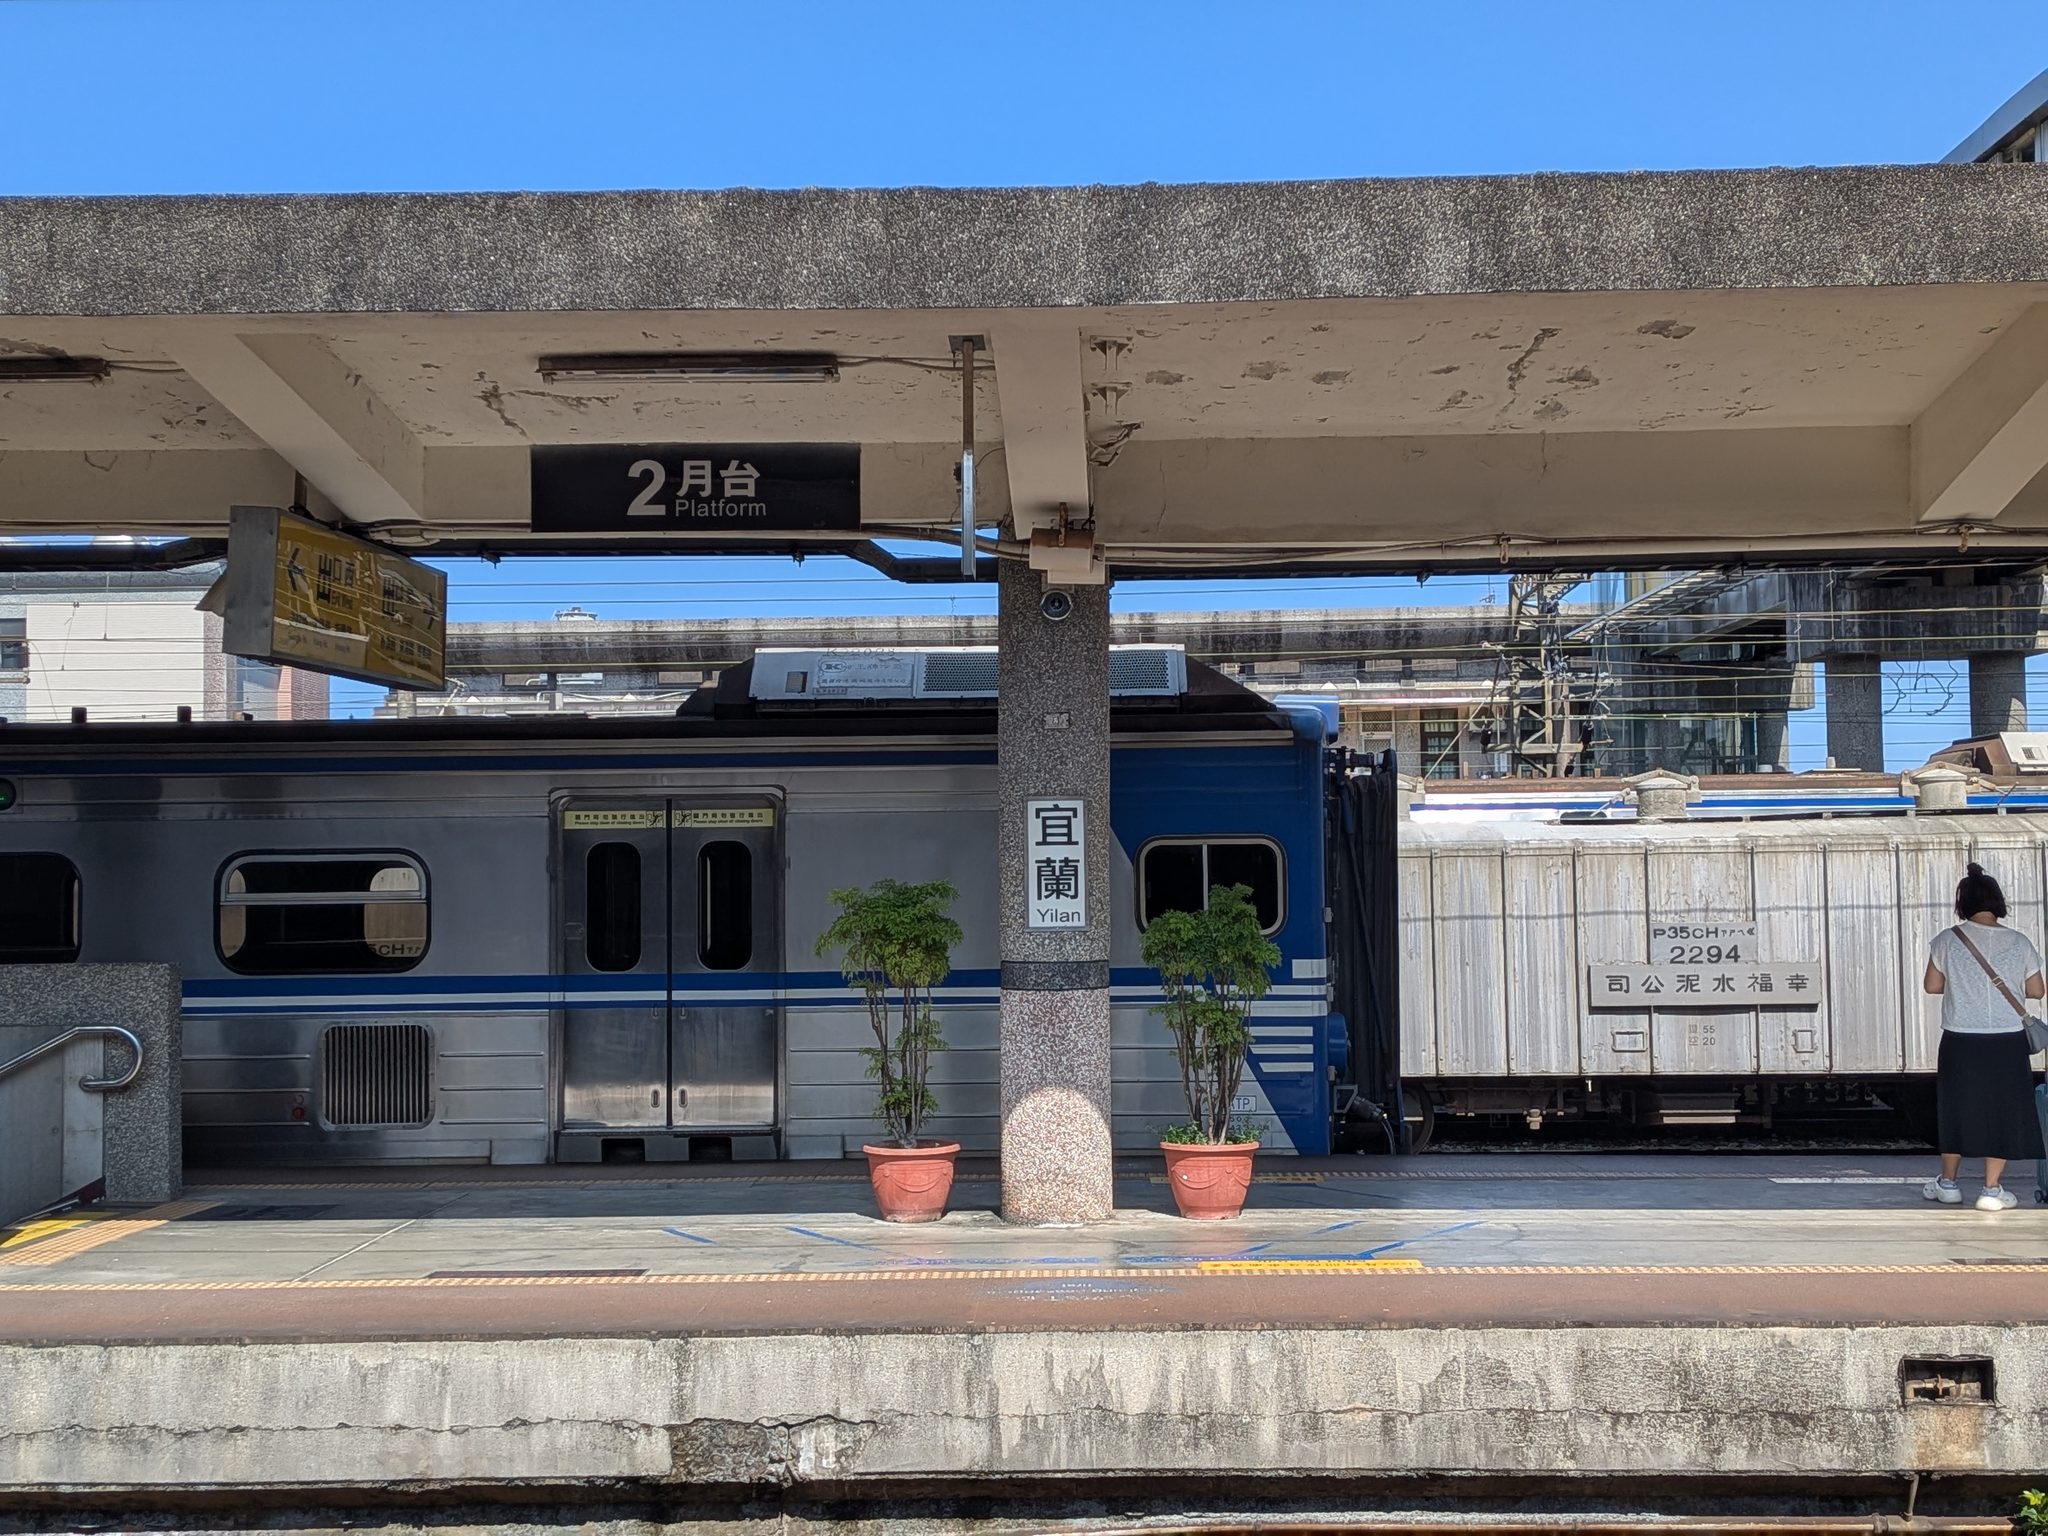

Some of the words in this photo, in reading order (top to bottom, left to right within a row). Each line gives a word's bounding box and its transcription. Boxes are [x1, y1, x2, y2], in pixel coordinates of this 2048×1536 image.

[626, 459, 667, 516] 2
[676, 460, 761, 498] 月台
[675, 499, 767, 517] Platform
[1034, 803, 1081, 901] 宜蘭
[1036, 908, 1081, 923] Yilan
[1669, 944, 1741, 965] 2294
[1702, 1037, 1716, 1046] 20
